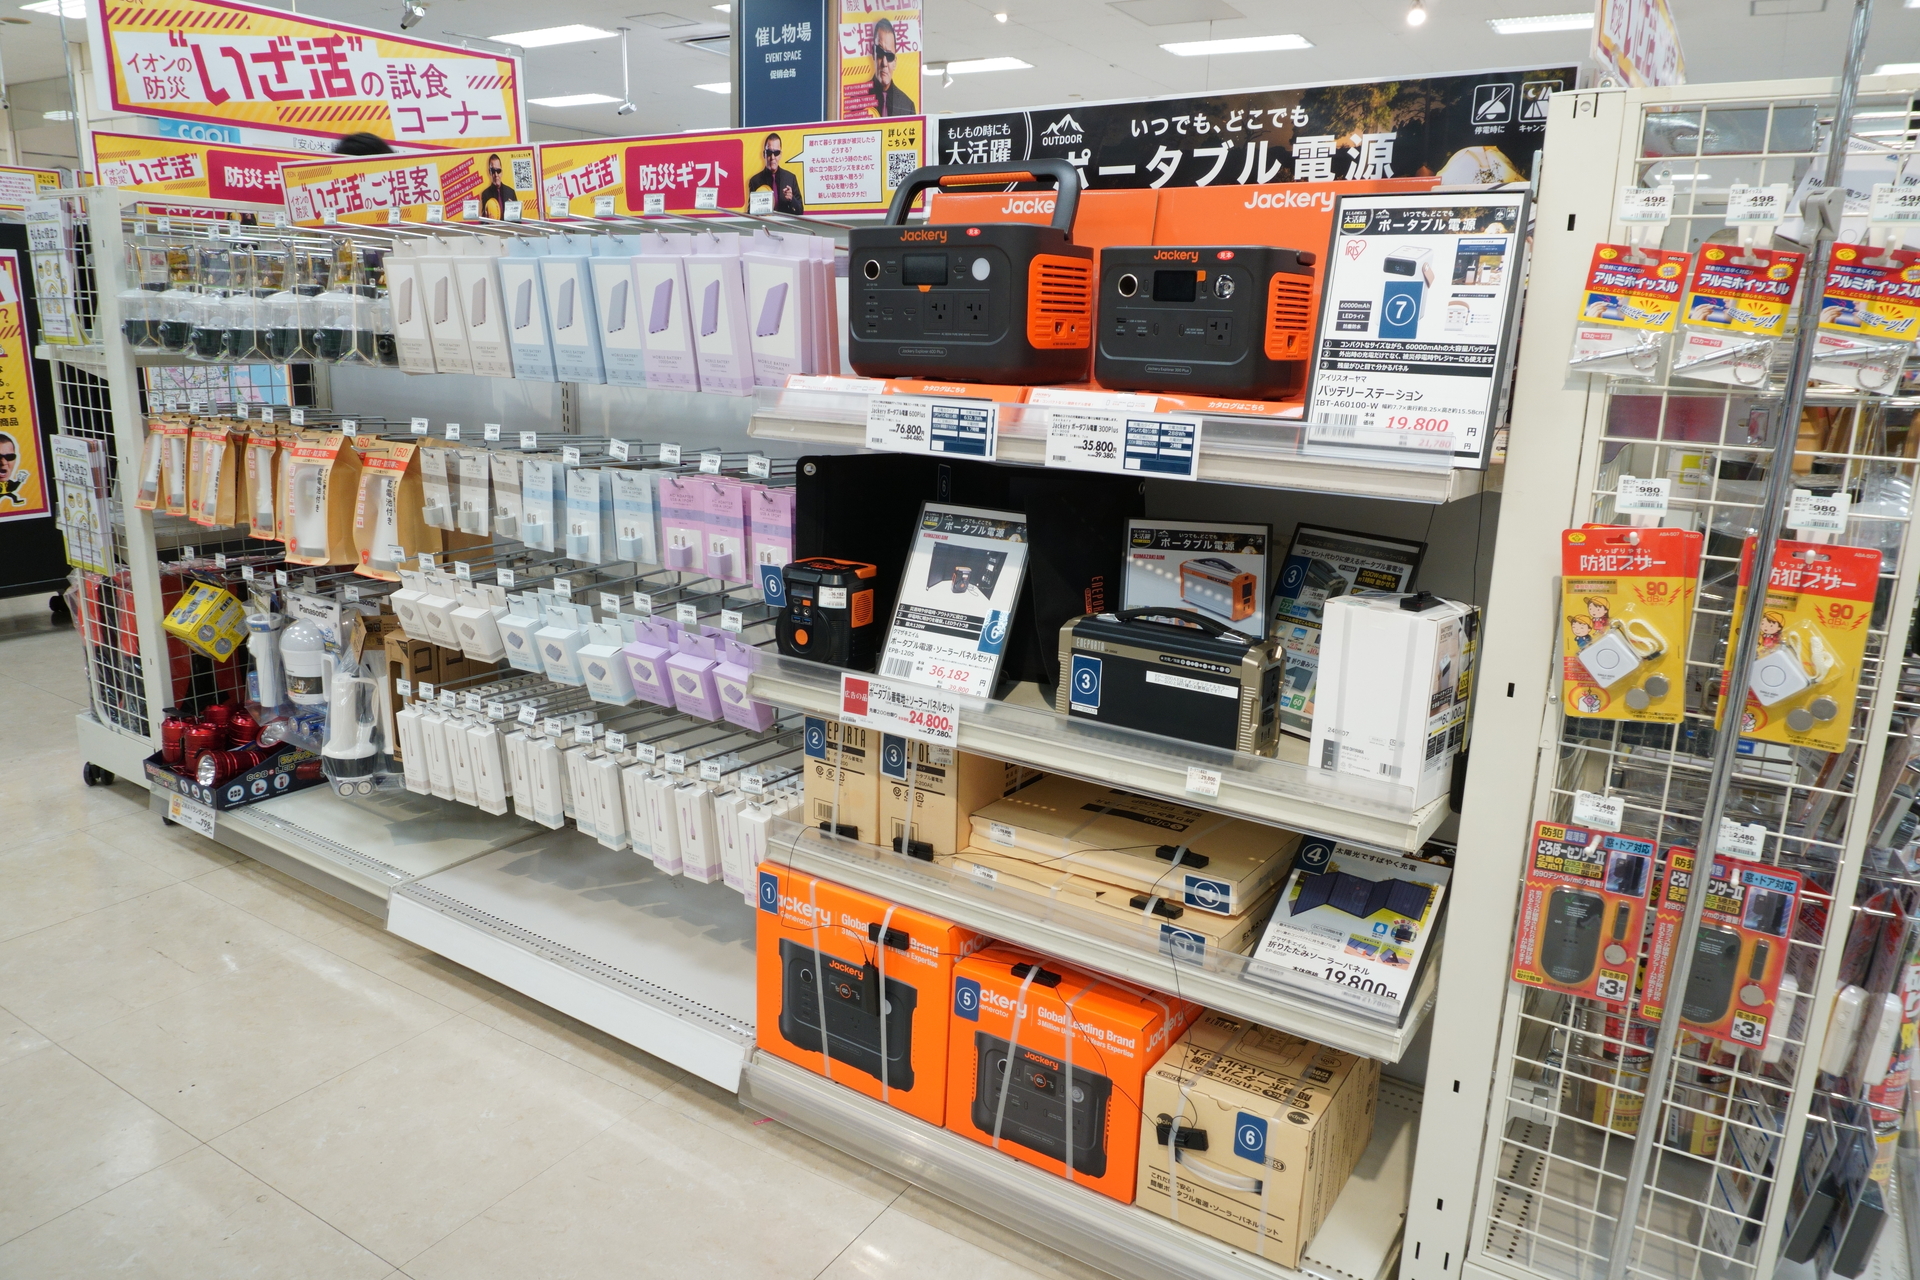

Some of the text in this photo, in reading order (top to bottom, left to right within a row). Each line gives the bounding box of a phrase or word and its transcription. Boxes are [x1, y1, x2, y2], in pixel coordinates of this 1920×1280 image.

[755, 22, 812, 47] 催し物場
[127, 53, 192, 73] イオンの
[765, 50, 802, 63] EVENT SPACE
[770, 68, 796, 80] 促销会场
[143, 76, 190, 100] 防災
[399, 105, 503, 136] コーナー
[1131, 105, 1311, 139] いつでも、どこでも
[888, 128, 916, 138] 詳しくは
[947, 123, 1012, 140] もしもの時にも
[1475, 125, 1505, 134] 停電時に
[809, 136, 876, 147] 離れて暮らす家族が被災したら
[888, 138, 908, 147] こちら
[1041, 133, 1083, 146] OUTDOOR
[945, 137, 1012, 165] 大活躍
[811, 155, 873, 164] そんないざという時のために
[1053, 131, 1398, 190] ポータブル電源
[103, 167, 128, 177] イオンの
[809, 164, 875, 174] 役に立つ防災グッズをまとめて
[109, 175, 127, 186] 防災
[639, 161, 729, 192] 防災ギフト
[826, 183, 859, 191] 安心を贈り合う
[1001, 198, 1055, 215] Jacke
[1244, 190, 1337, 212] Jackery
[1643, 196, 1666, 204] 498
[1344, 215, 1367, 224] 大活躍
[1402, 210, 1454, 218] いつでも、どこでも
[1378, 217, 1477, 233] ポータブル電源
[900, 230, 947, 243] Jackery
[1153, 250, 1199, 263] Jackery
[1593, 271, 1679, 294] アルミホイッスル
[1698, 273, 1790, 296] アルミホイッスル
[1395, 301, 1407, 319] 7
[1581, 332, 1612, 340] IDカード付
[1691, 338, 1721, 347] IDカード付
[1337, 362, 1409, 372] 残量がひと目で分かるパネル
[1319, 373, 1367, 383] アイリスオーヤマ
[923, 385, 966, 394] カタログはこちら
[1318, 385, 1424, 402] バッテリーステーション
[1208, 400, 1265, 412] カタログはこちら
[1316, 399, 1379, 410] IBT-A60100-W
[1386, 416, 1449, 433] 19,800
[1467, 427, 1477, 437] 円
[324, 437, 336, 447] 150
[356, 437, 370, 448] 150
[1463, 442, 1471, 450] 円
[393, 447, 406, 458] 150
[1813, 504, 1837, 512] 980
[944, 521, 1005, 538] ポータブル電源
[1160, 538, 1235, 551] ポータブル電源
[1301, 548, 1404, 573] コンセント代わりに使えるポータブル蓄電池
[1580, 555, 1666, 572] 防犯ブザー
[1780, 561, 1842, 573] ひっぱりやすい
[1288, 569, 1297, 583] 3
[769, 579, 777, 593] 6
[1646, 581, 1668, 596] 90
[299, 604, 328, 619] Panasonic
[1829, 603, 1854, 619] 90
[893, 628, 919, 639] クマザキエイム
[990, 625, 999, 639] 6
[890, 637, 994, 664] ポータブル電源・ソーラーパネルセット
[928, 665, 970, 682] 36,182
[1081, 673, 1091, 689] 3
[844, 690, 868, 702] 広告の品
[812, 732, 818, 744] 2
[890, 749, 898, 762] 3
[1595, 802, 1616, 811] 2,480
[1541, 826, 1587, 843] 防犯 超薄型
[1733, 832, 1755, 841] 2,480
[1605, 837, 1651, 854] 窓・ドア対応
[1307, 847, 1322, 862] 4
[1335, 846, 1418, 872] 太陽光ですばやく充電
[1745, 872, 1795, 891] 窓・ドア対応
[766, 886, 772, 900] 1
[778, 894, 831, 928] ackery
[841, 913, 939, 958] Global Brand
[1270, 935, 1307, 950] クマザキエイム
[910, 952, 939, 968] Expertise
[1267, 941, 1371, 976] 折りたたみソーラーパネル
[828, 959, 864, 981] Jackery
[1601, 970, 1628, 981] 電池寿命
[963, 992, 971, 1005] 5
[1736, 1010, 1766, 1025] 電池寿命
[1037, 1006, 1136, 1049] Global Leading Brand
[1041, 1019, 1060, 1033] Million
[1090, 1036, 1106, 1049] Years
[1106, 1041, 1135, 1059] Expertise
[1024, 1051, 1059, 1071] Jackery
[1245, 1130, 1255, 1145] 6
